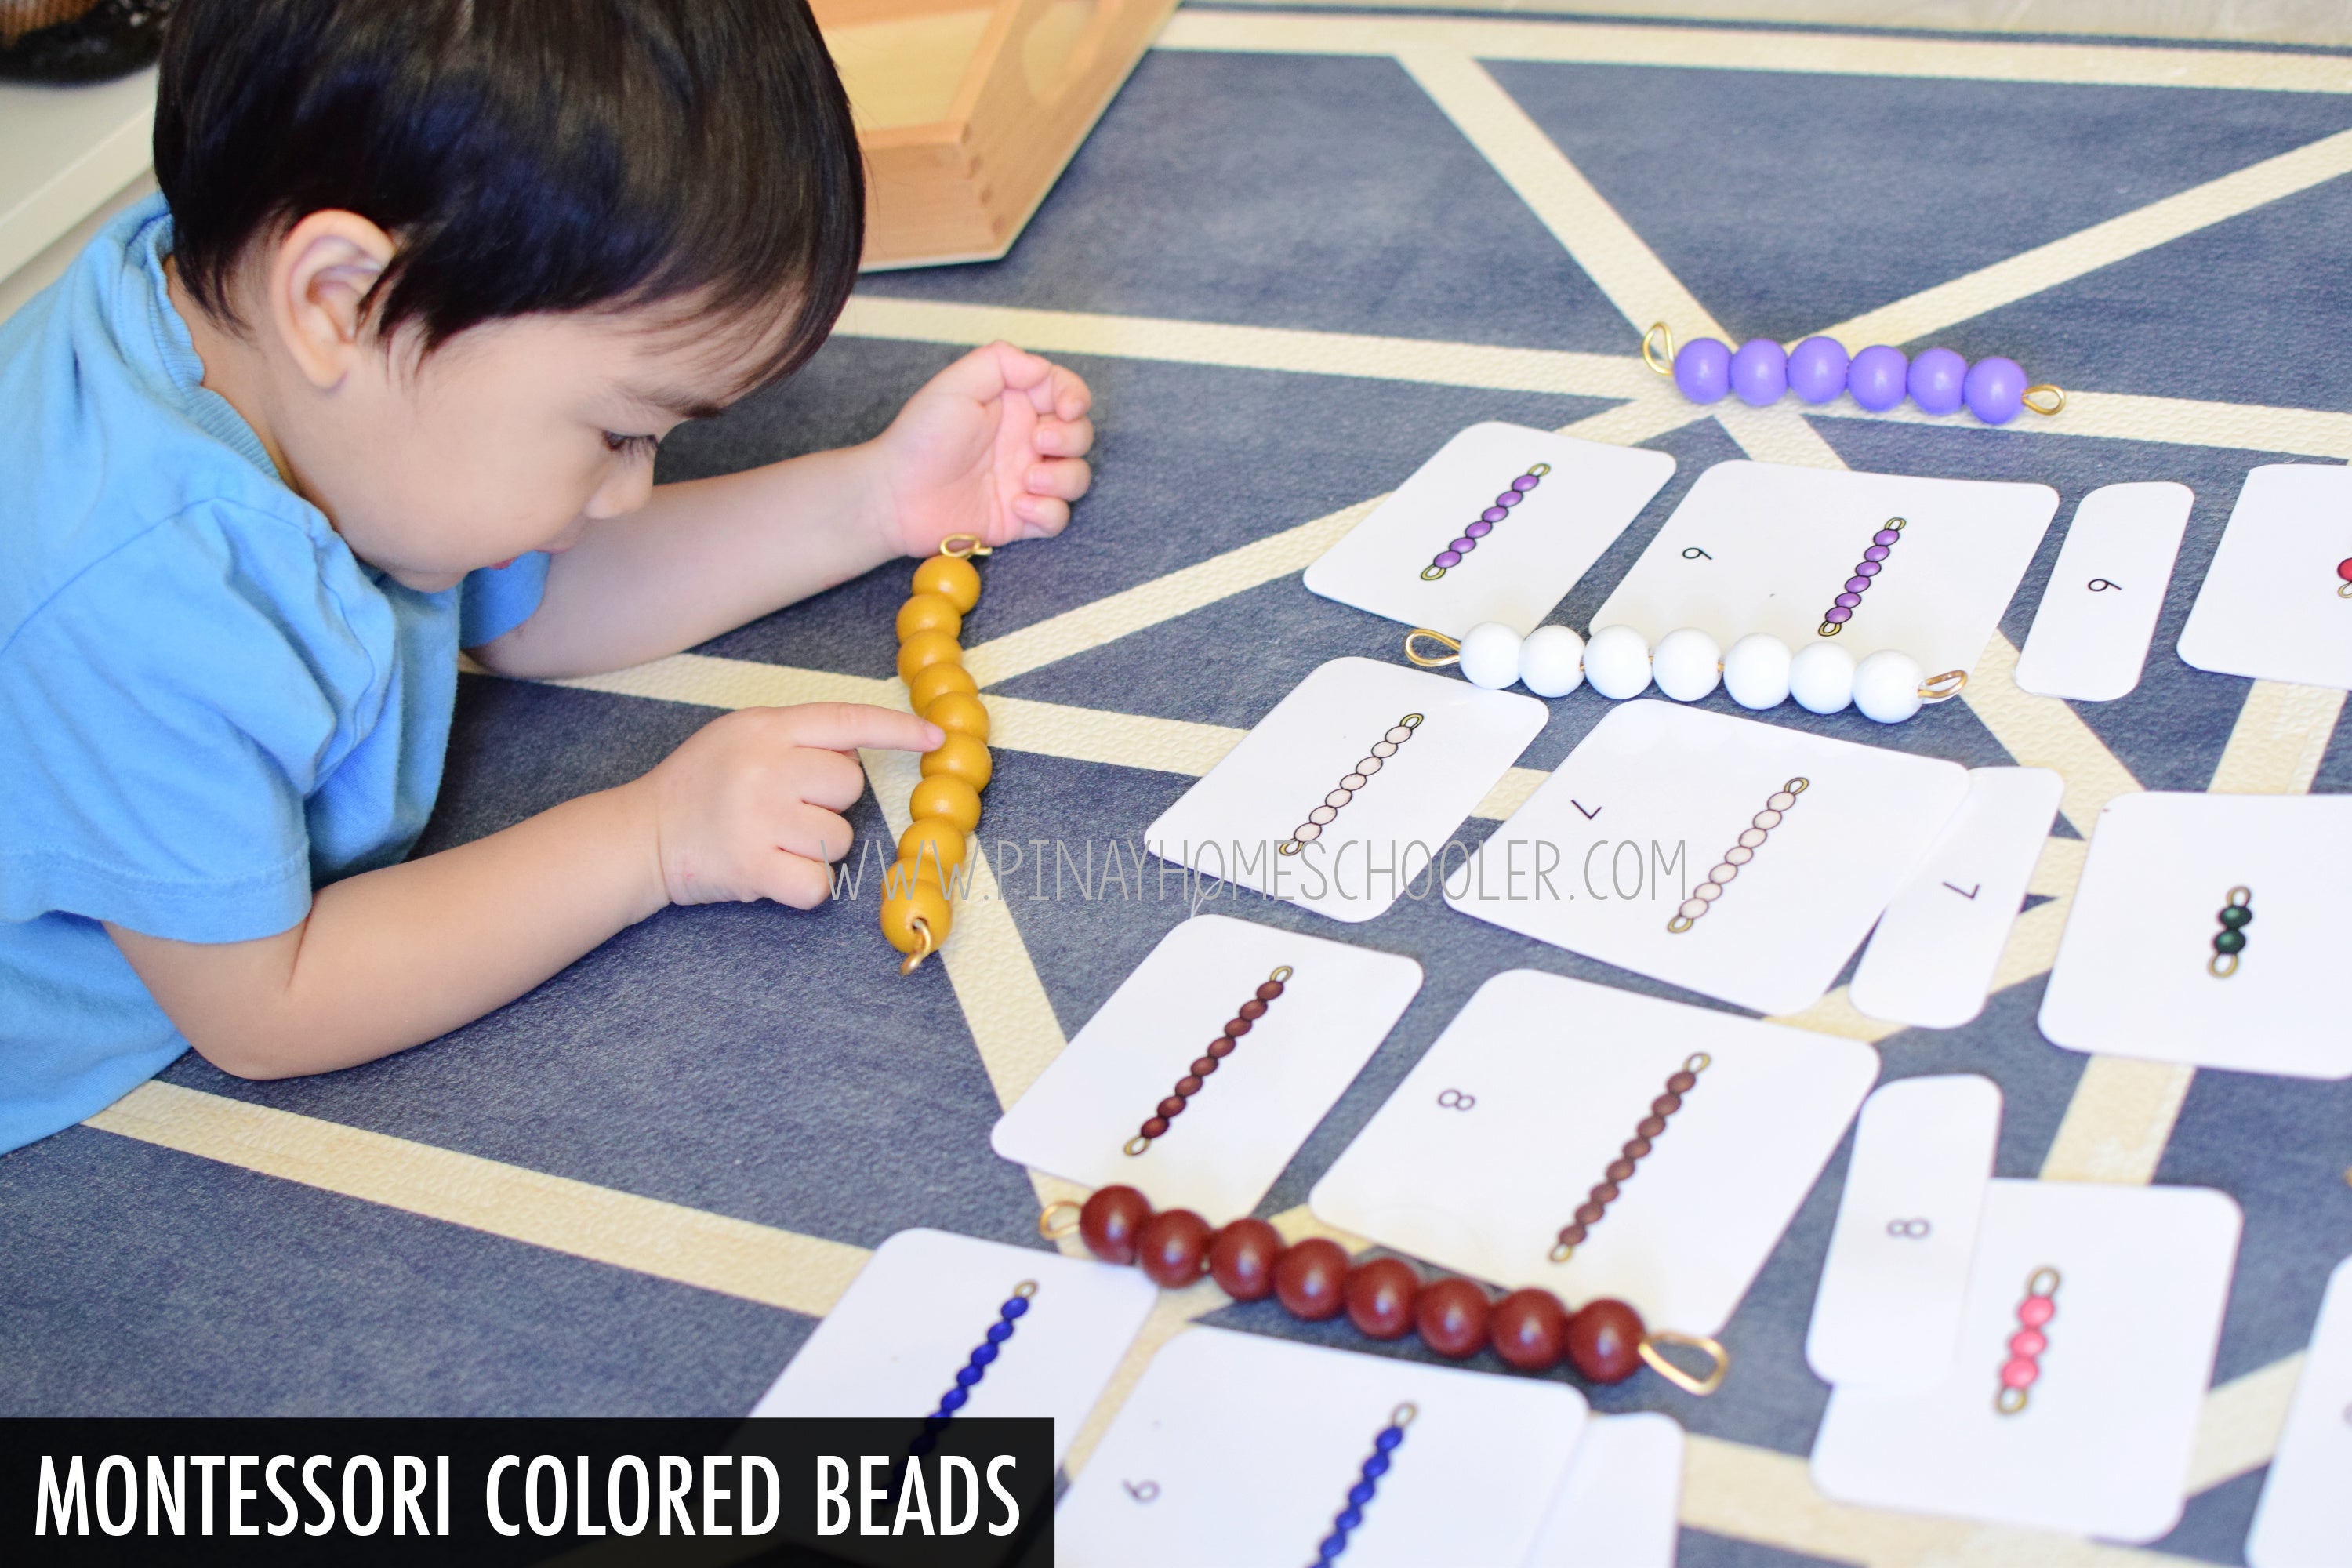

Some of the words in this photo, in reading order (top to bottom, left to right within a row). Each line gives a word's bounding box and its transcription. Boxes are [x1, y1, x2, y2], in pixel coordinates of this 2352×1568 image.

[1570, 798, 1603, 822] 7
[1941, 881, 1980, 901] 7
[1436, 1087, 1476, 1112] 8
[1886, 1217, 1932, 1240] 8
